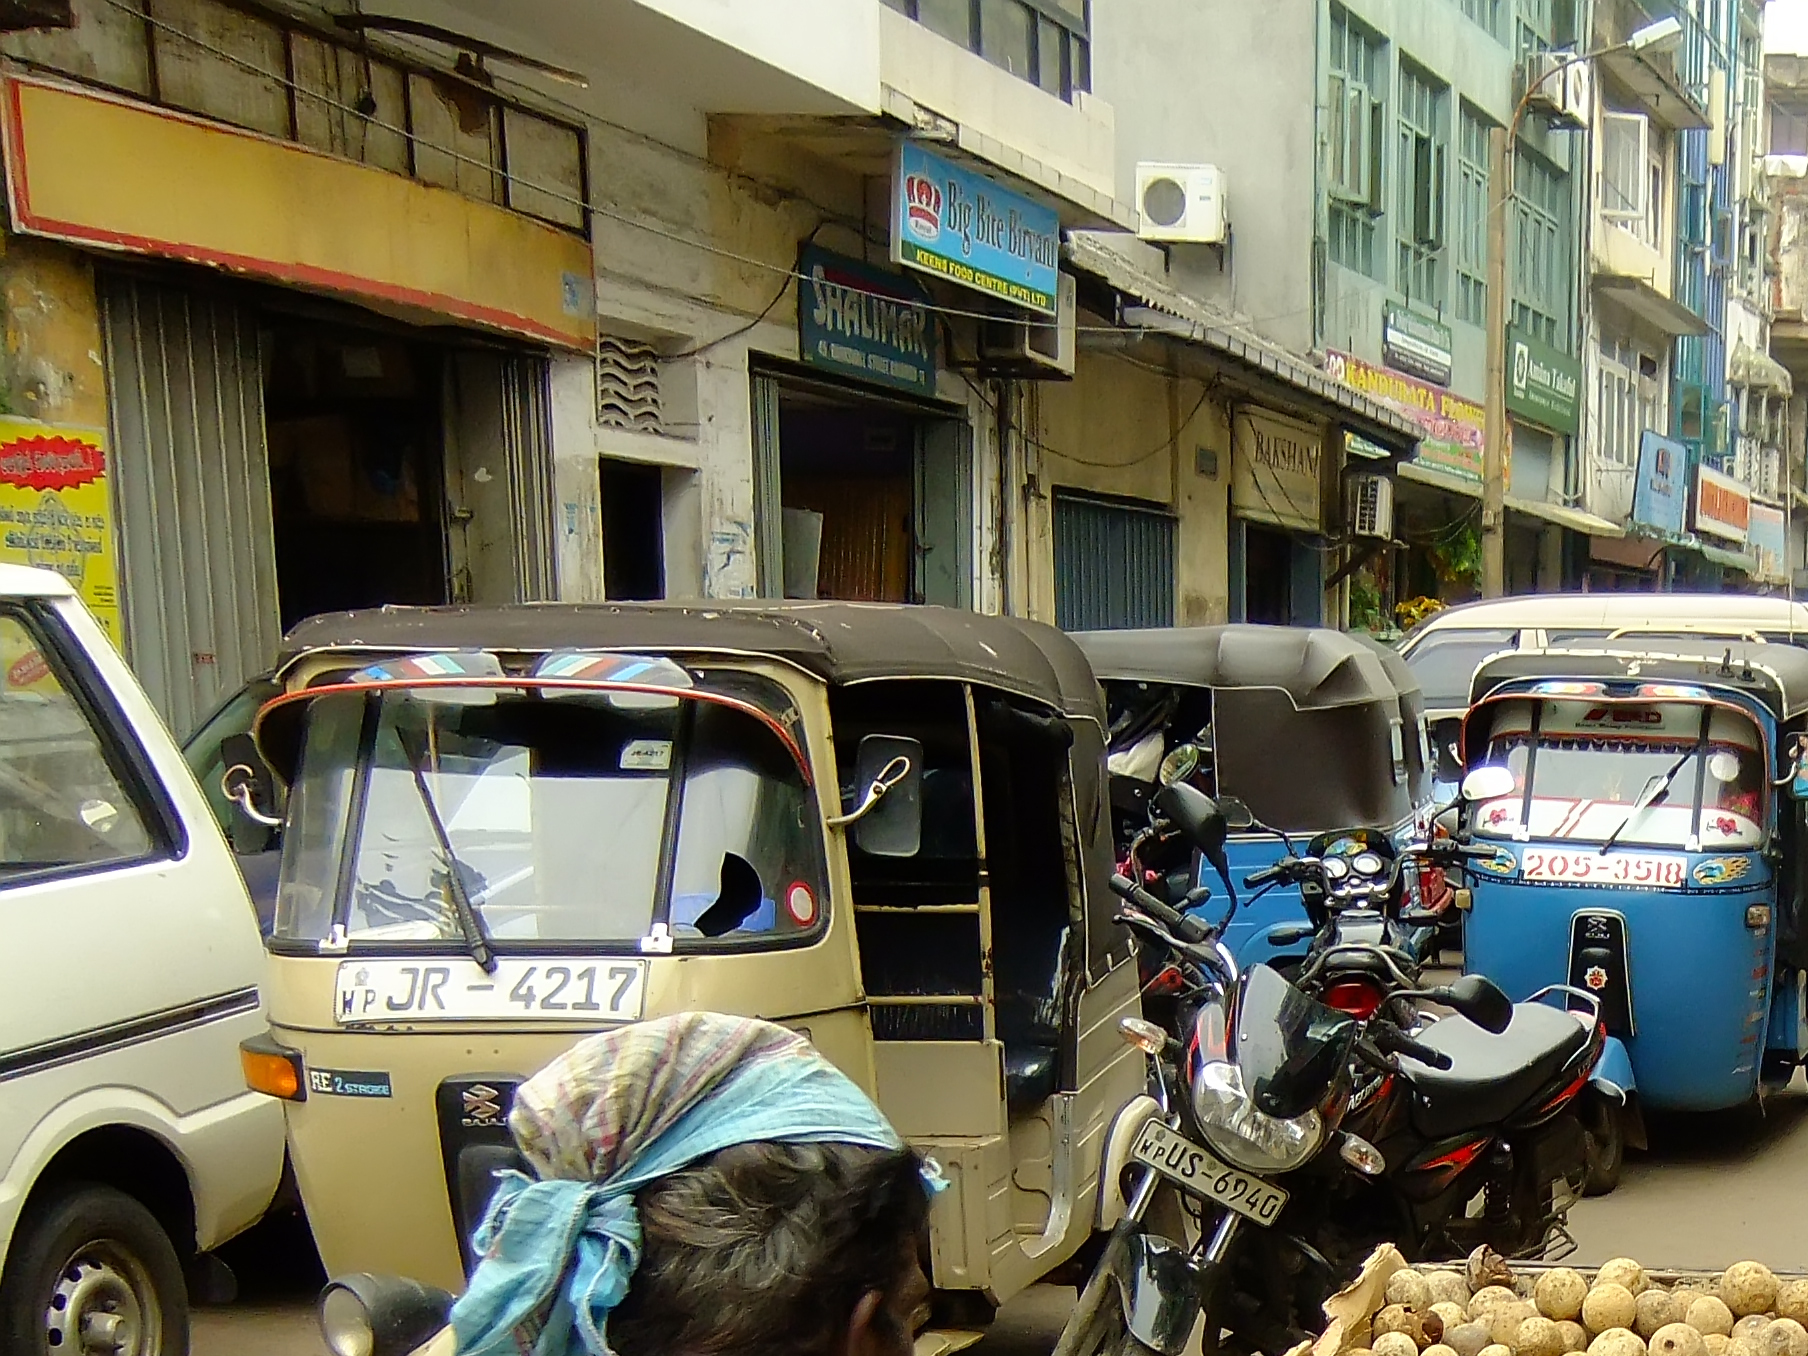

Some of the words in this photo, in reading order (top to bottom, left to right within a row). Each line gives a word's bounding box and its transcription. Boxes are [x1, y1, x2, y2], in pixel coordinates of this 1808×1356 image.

[946, 181, 973, 257] Big
[975, 194, 1005, 250] Bite
[1008, 209, 1055, 280] Biryani
[949, 262, 973, 282] FOOD
[975, 273, 1009, 293] CENTRE
[1031, 292, 1046, 307] LTD
[1345, 360, 1435, 414] KANDURATA
[1526, 854, 1683, 885] 205-3518
[385, 966, 451, 1012] JR
[509, 966, 638, 1012] 4217
[310, 1071, 334, 1092] RE
[334, 1076, 343, 1094] 2
[1164, 1142, 1280, 1219] US-6940
